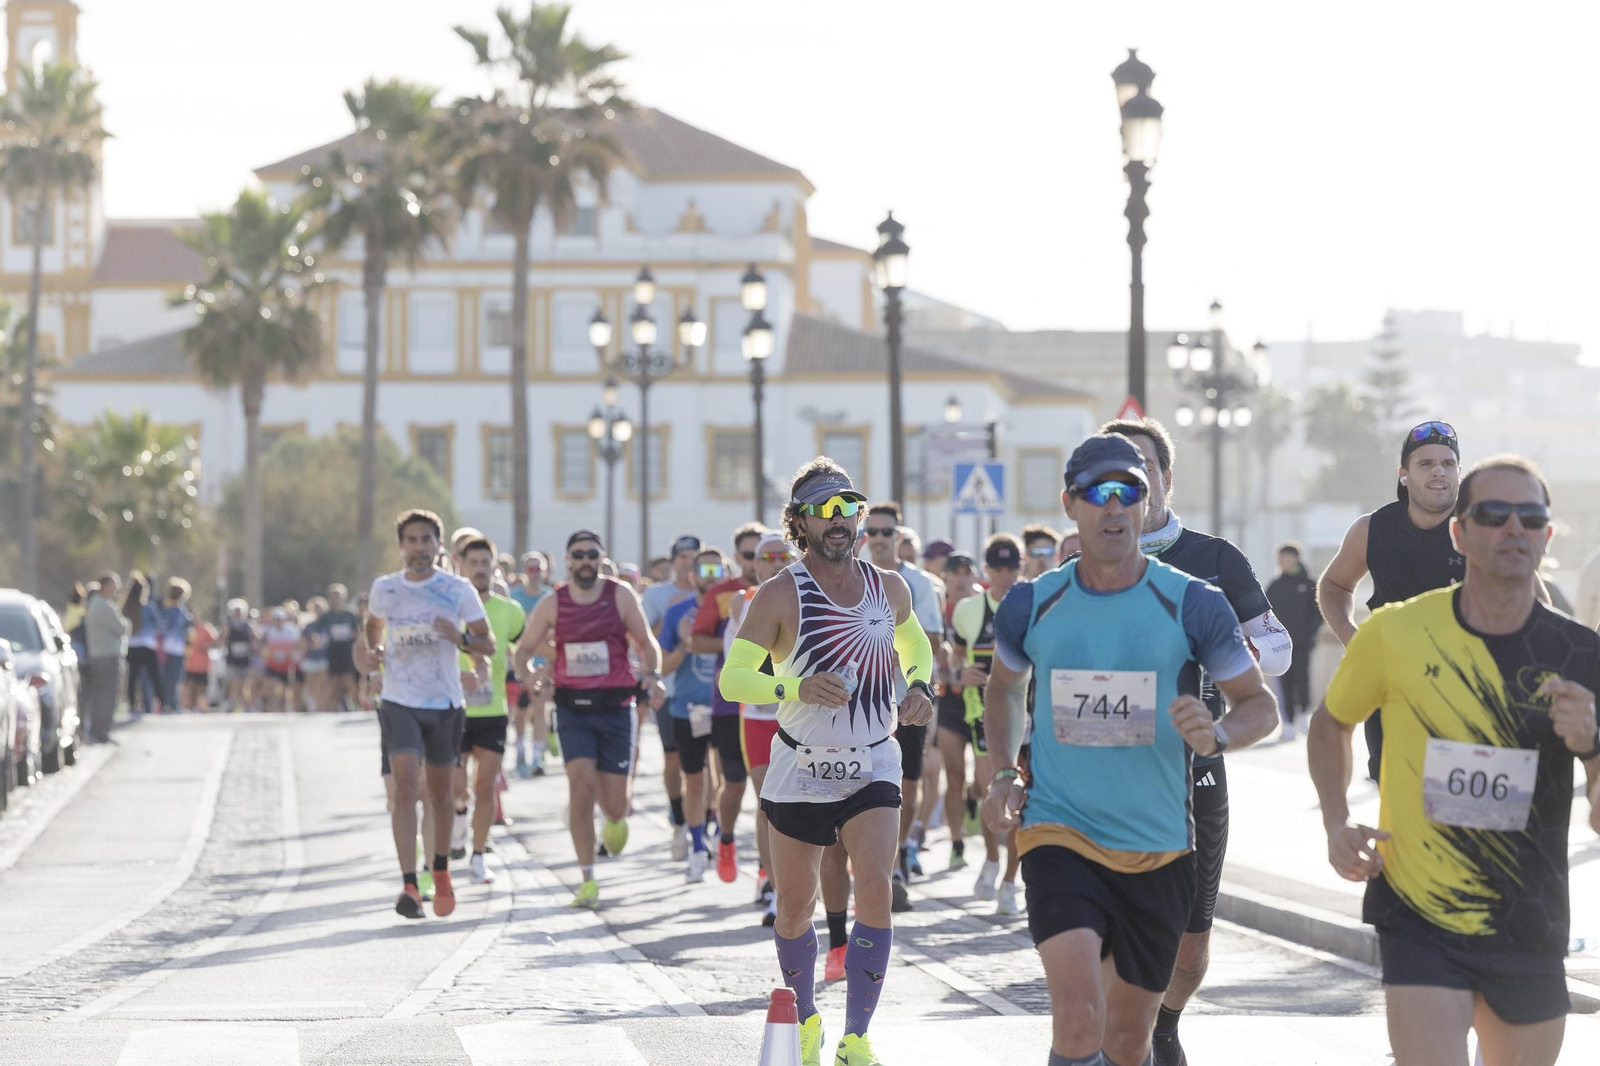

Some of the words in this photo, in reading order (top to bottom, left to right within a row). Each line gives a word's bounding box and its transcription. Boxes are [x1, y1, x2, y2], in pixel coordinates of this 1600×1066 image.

[1073, 693, 1131, 720] 744
[807, 760, 861, 780] 1292
[1448, 767, 1509, 801] 606
